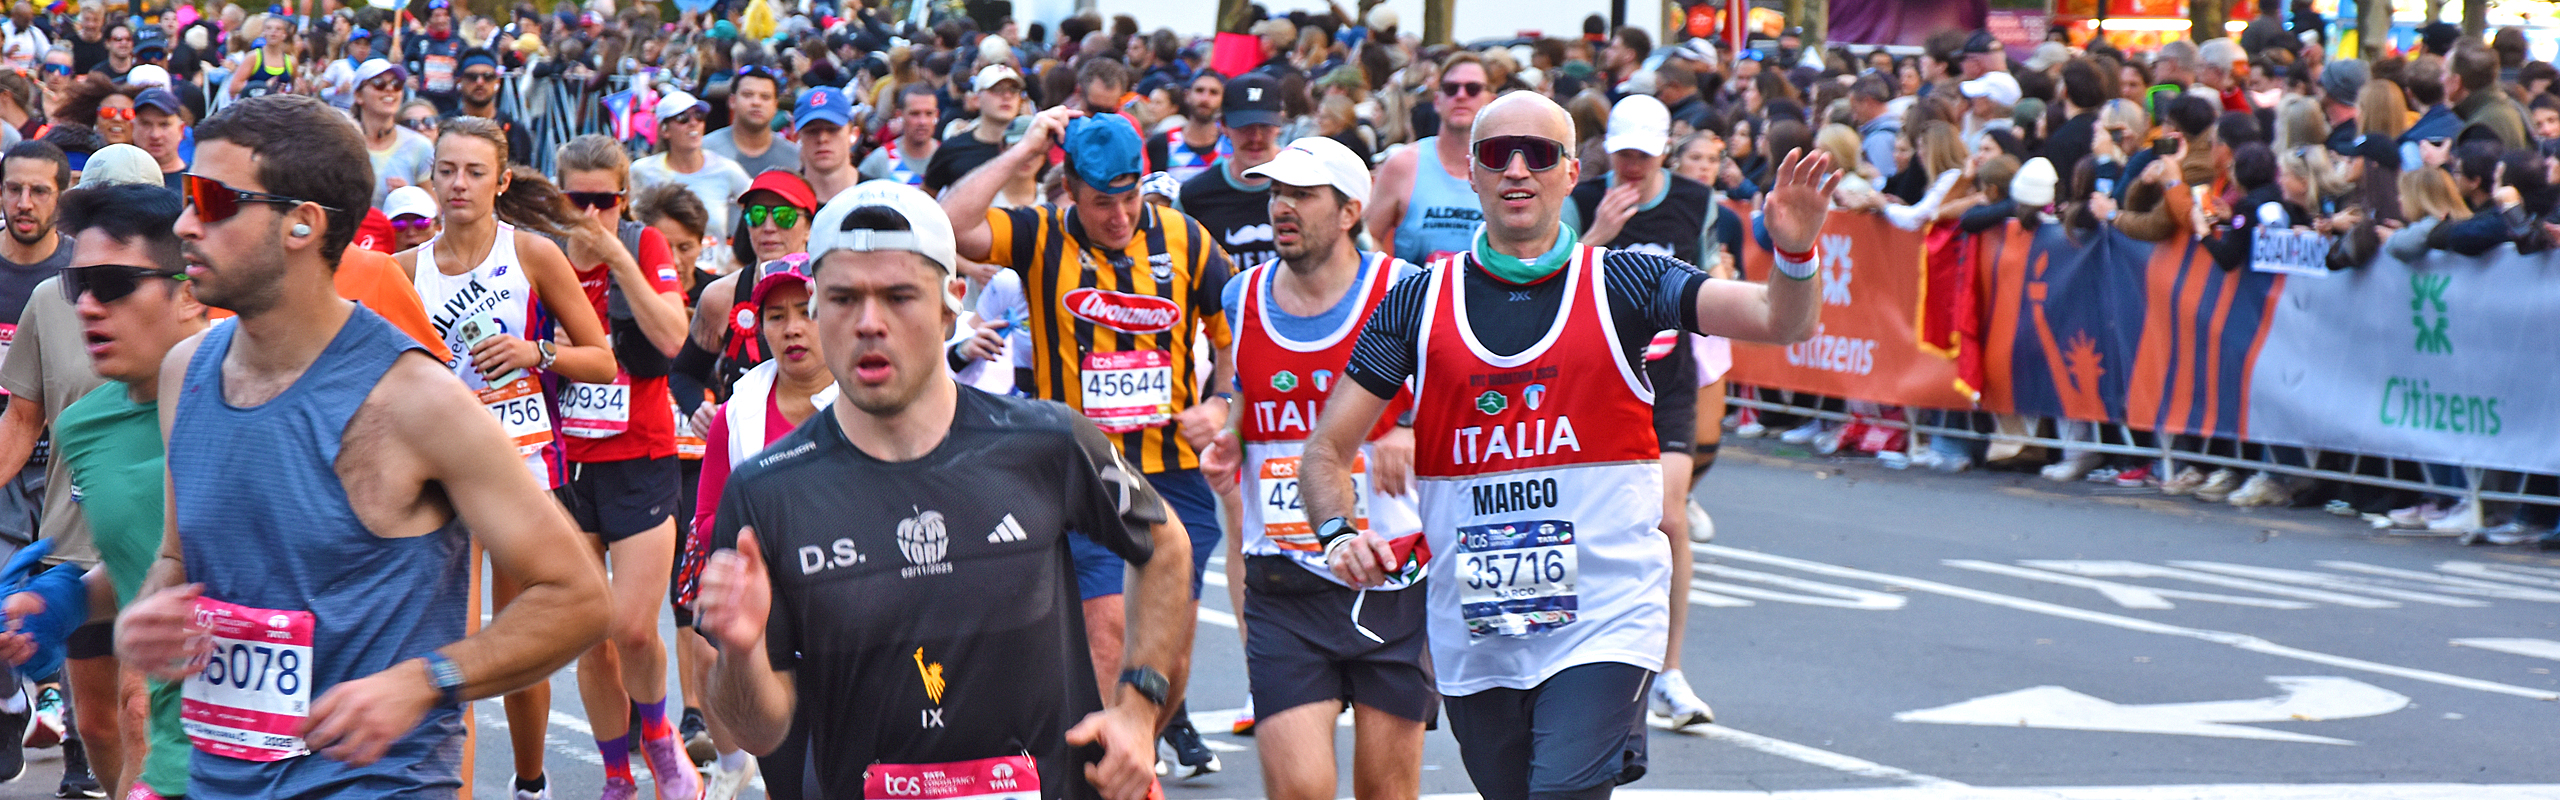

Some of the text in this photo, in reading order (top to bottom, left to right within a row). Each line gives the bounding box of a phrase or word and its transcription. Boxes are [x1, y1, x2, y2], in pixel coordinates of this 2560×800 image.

[1424, 206, 1485, 221] ALDRID
[1088, 370, 1166, 397] 45644
[493, 398, 540, 426] 756
[2379, 375, 2501, 437] Citizens
[1453, 415, 1582, 465] ITALIA
[1472, 477, 1559, 517] MARCO
[896, 517, 948, 543] NEW
[798, 537, 867, 576] D.S.
[896, 536, 950, 566] YORK
[1466, 549, 1566, 591] 35716
[199, 642, 300, 697] 6078
[921, 707, 945, 729] IX
[884, 772, 921, 797] tcs
[989, 778, 1018, 790] TATA
